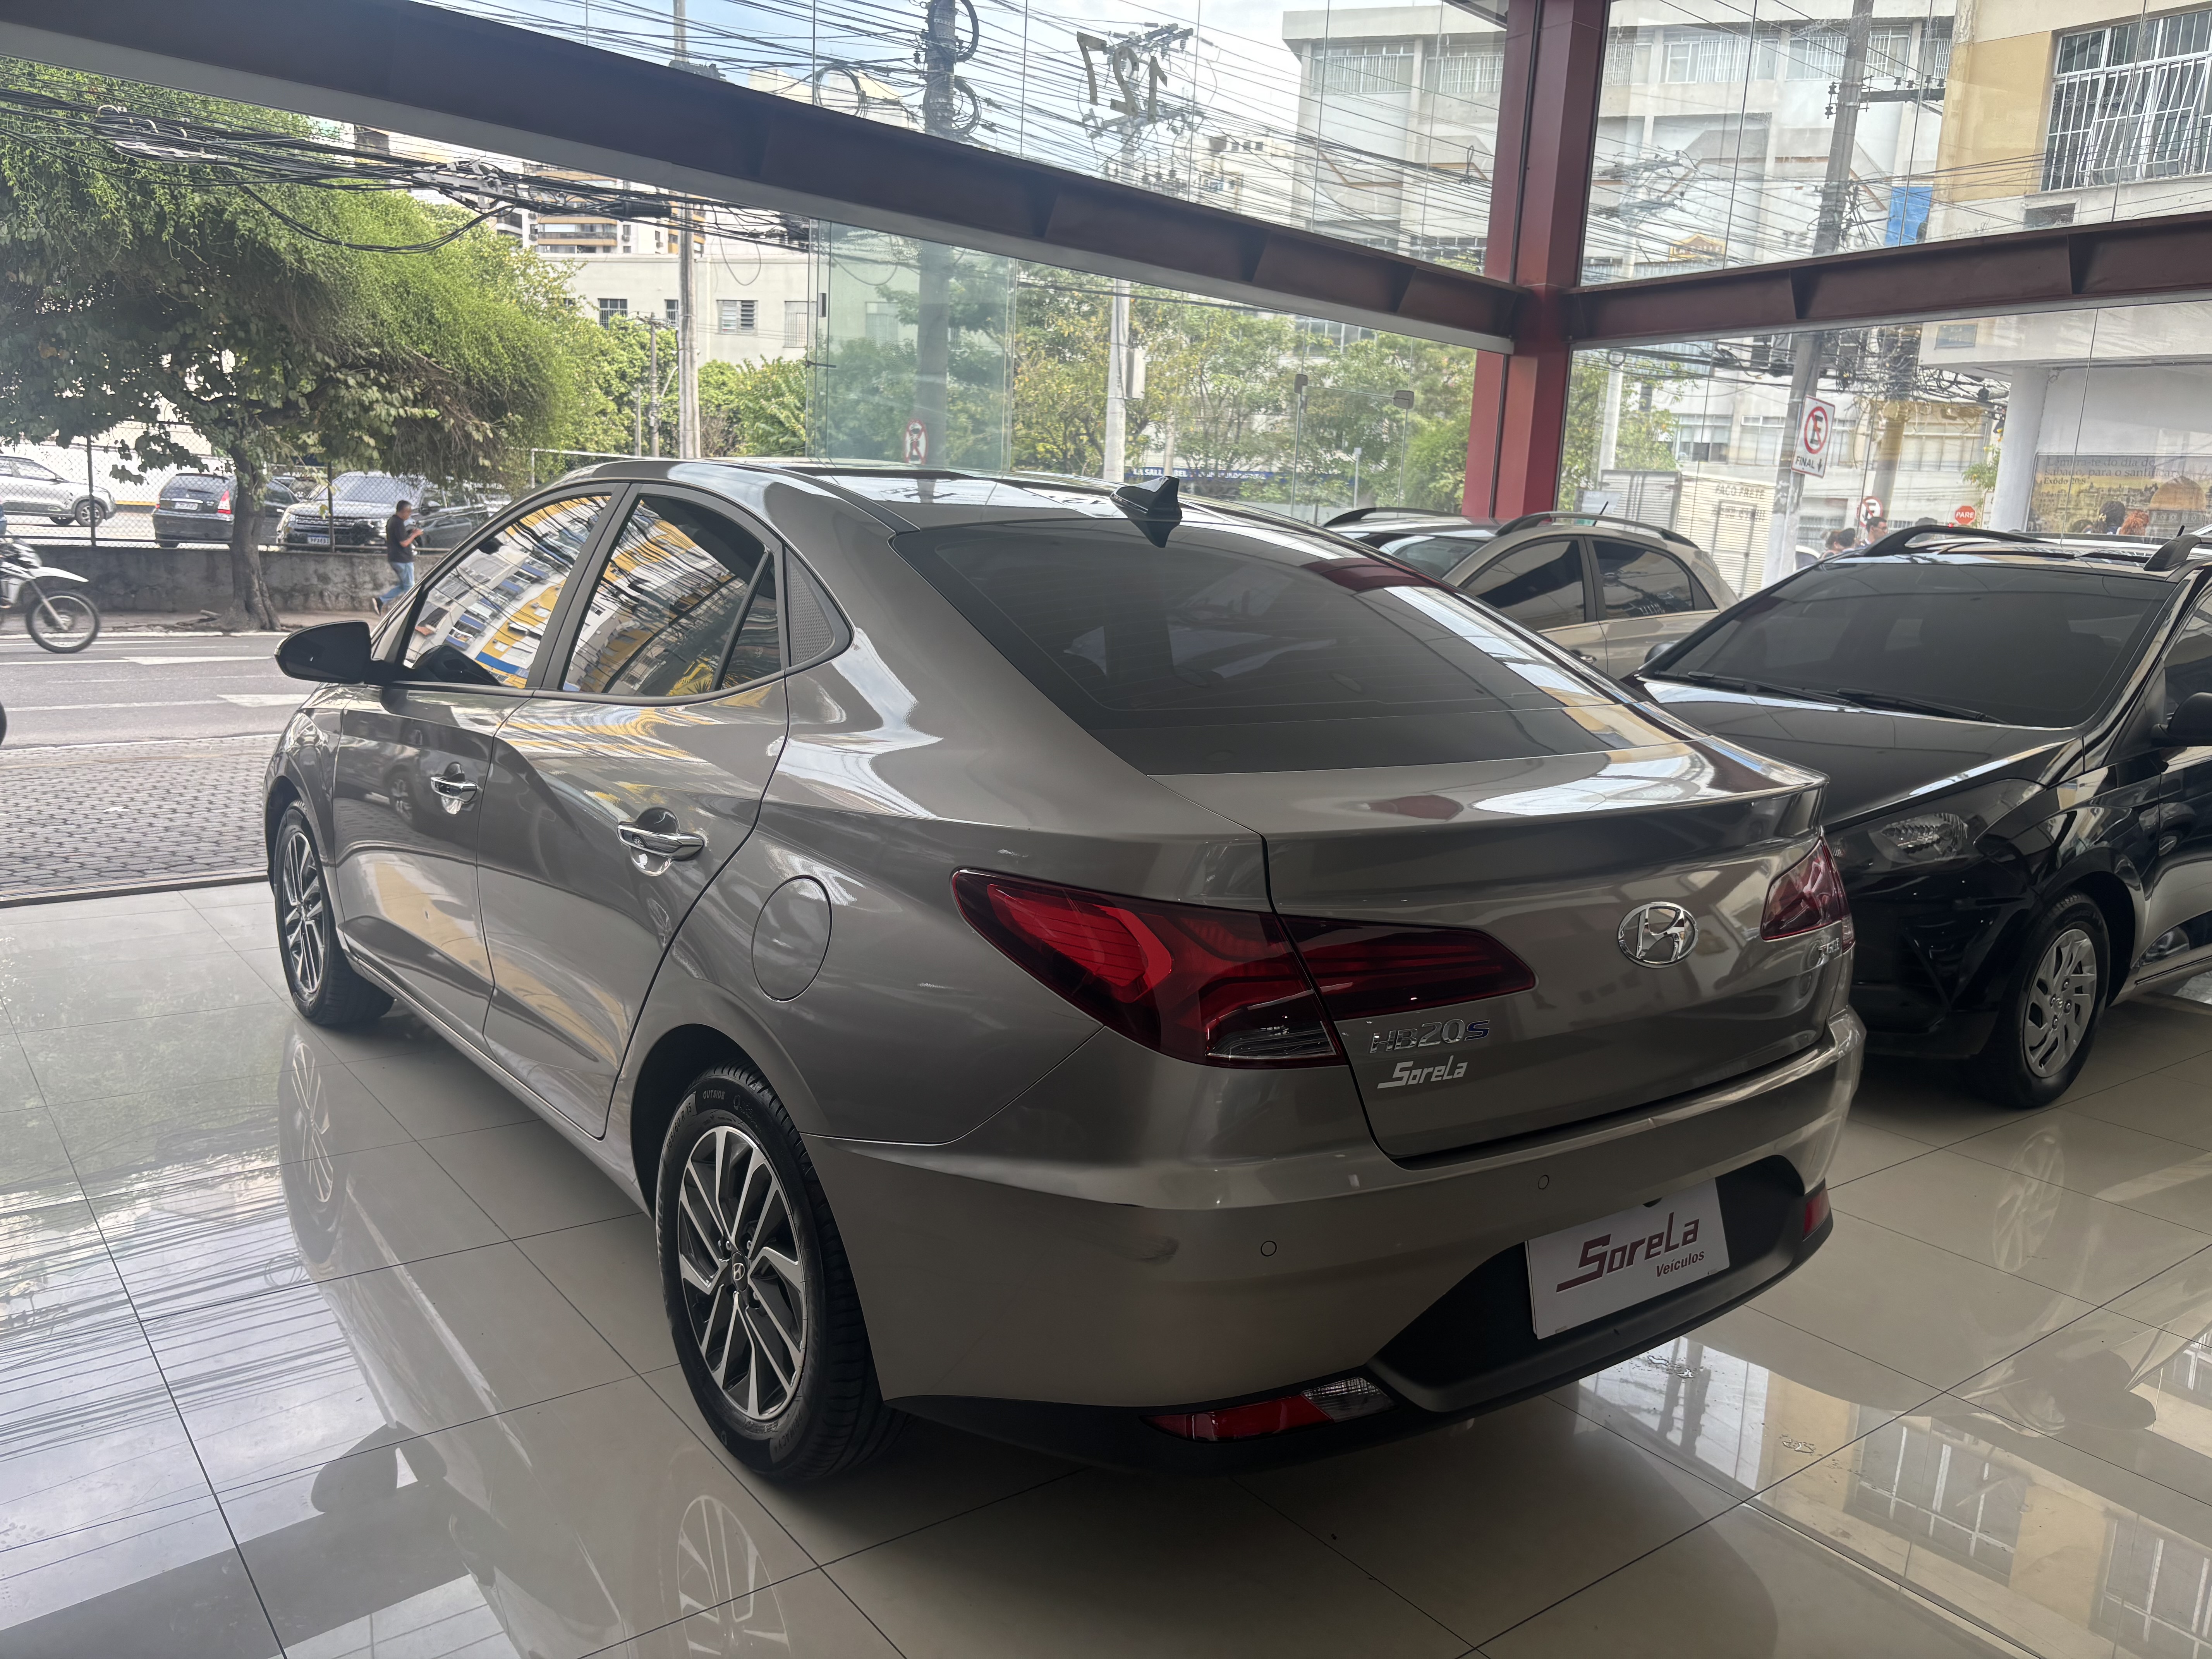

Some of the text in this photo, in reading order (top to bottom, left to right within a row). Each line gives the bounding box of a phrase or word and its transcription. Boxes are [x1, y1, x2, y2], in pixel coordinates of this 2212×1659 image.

[1796, 456, 1815, 469] FINAL
[2104, 457, 2118, 466] do
[2121, 457, 2137, 466] dia
[2088, 469, 2112, 479] para
[1370, 1019, 1490, 1053] HB20S
[703, 1089, 725, 1100] OUTSIDE
[682, 1110, 685, 1122] R
[686, 1102, 692, 1115] 15
[1656, 1251, 1704, 1277] Veículos
